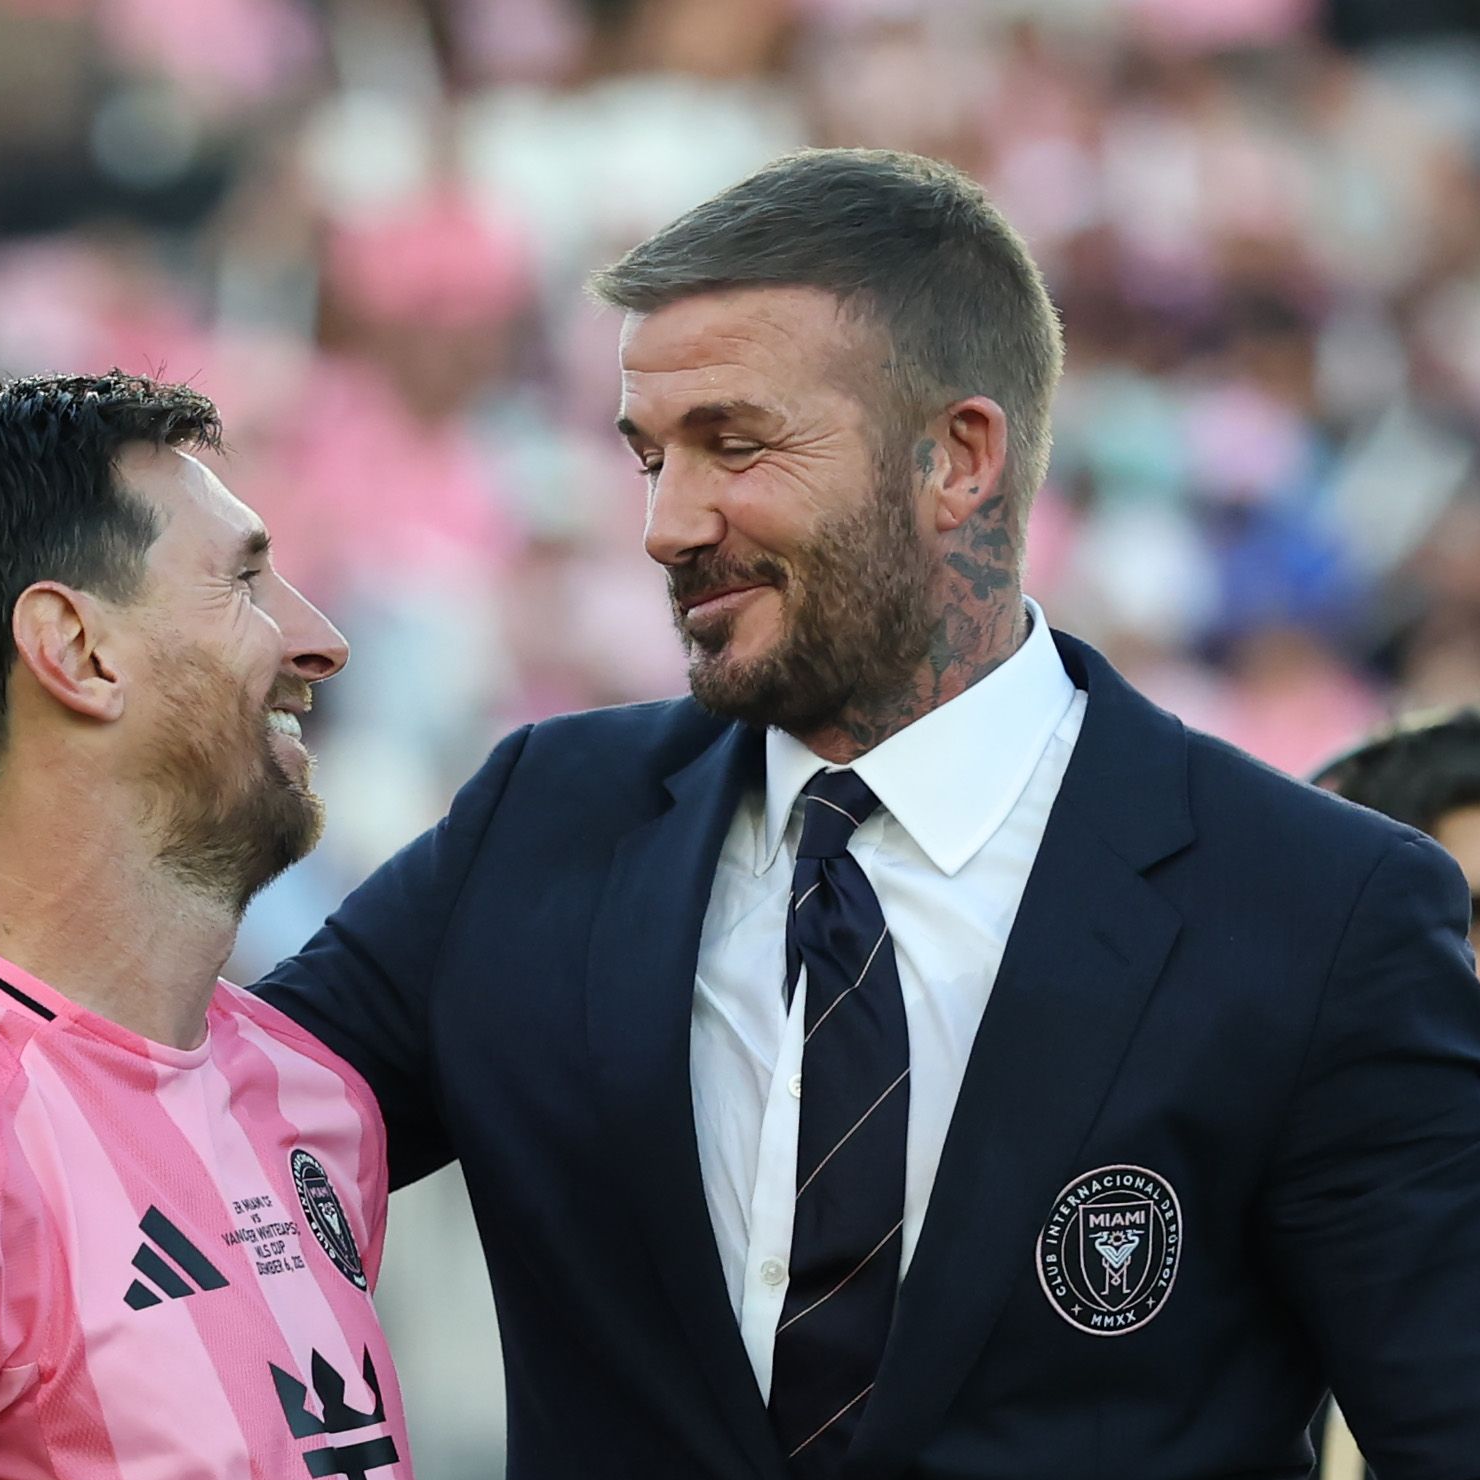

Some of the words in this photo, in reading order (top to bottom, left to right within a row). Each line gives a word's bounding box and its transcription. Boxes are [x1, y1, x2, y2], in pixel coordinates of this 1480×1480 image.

[1046, 1175, 1161, 1244] INTERNACIONAL
[1088, 1210, 1146, 1229] MIAMI
[1160, 1199, 1172, 1221] DE
[1046, 1254, 1067, 1296] CLUB
[1090, 1309, 1137, 1328] MMXX
